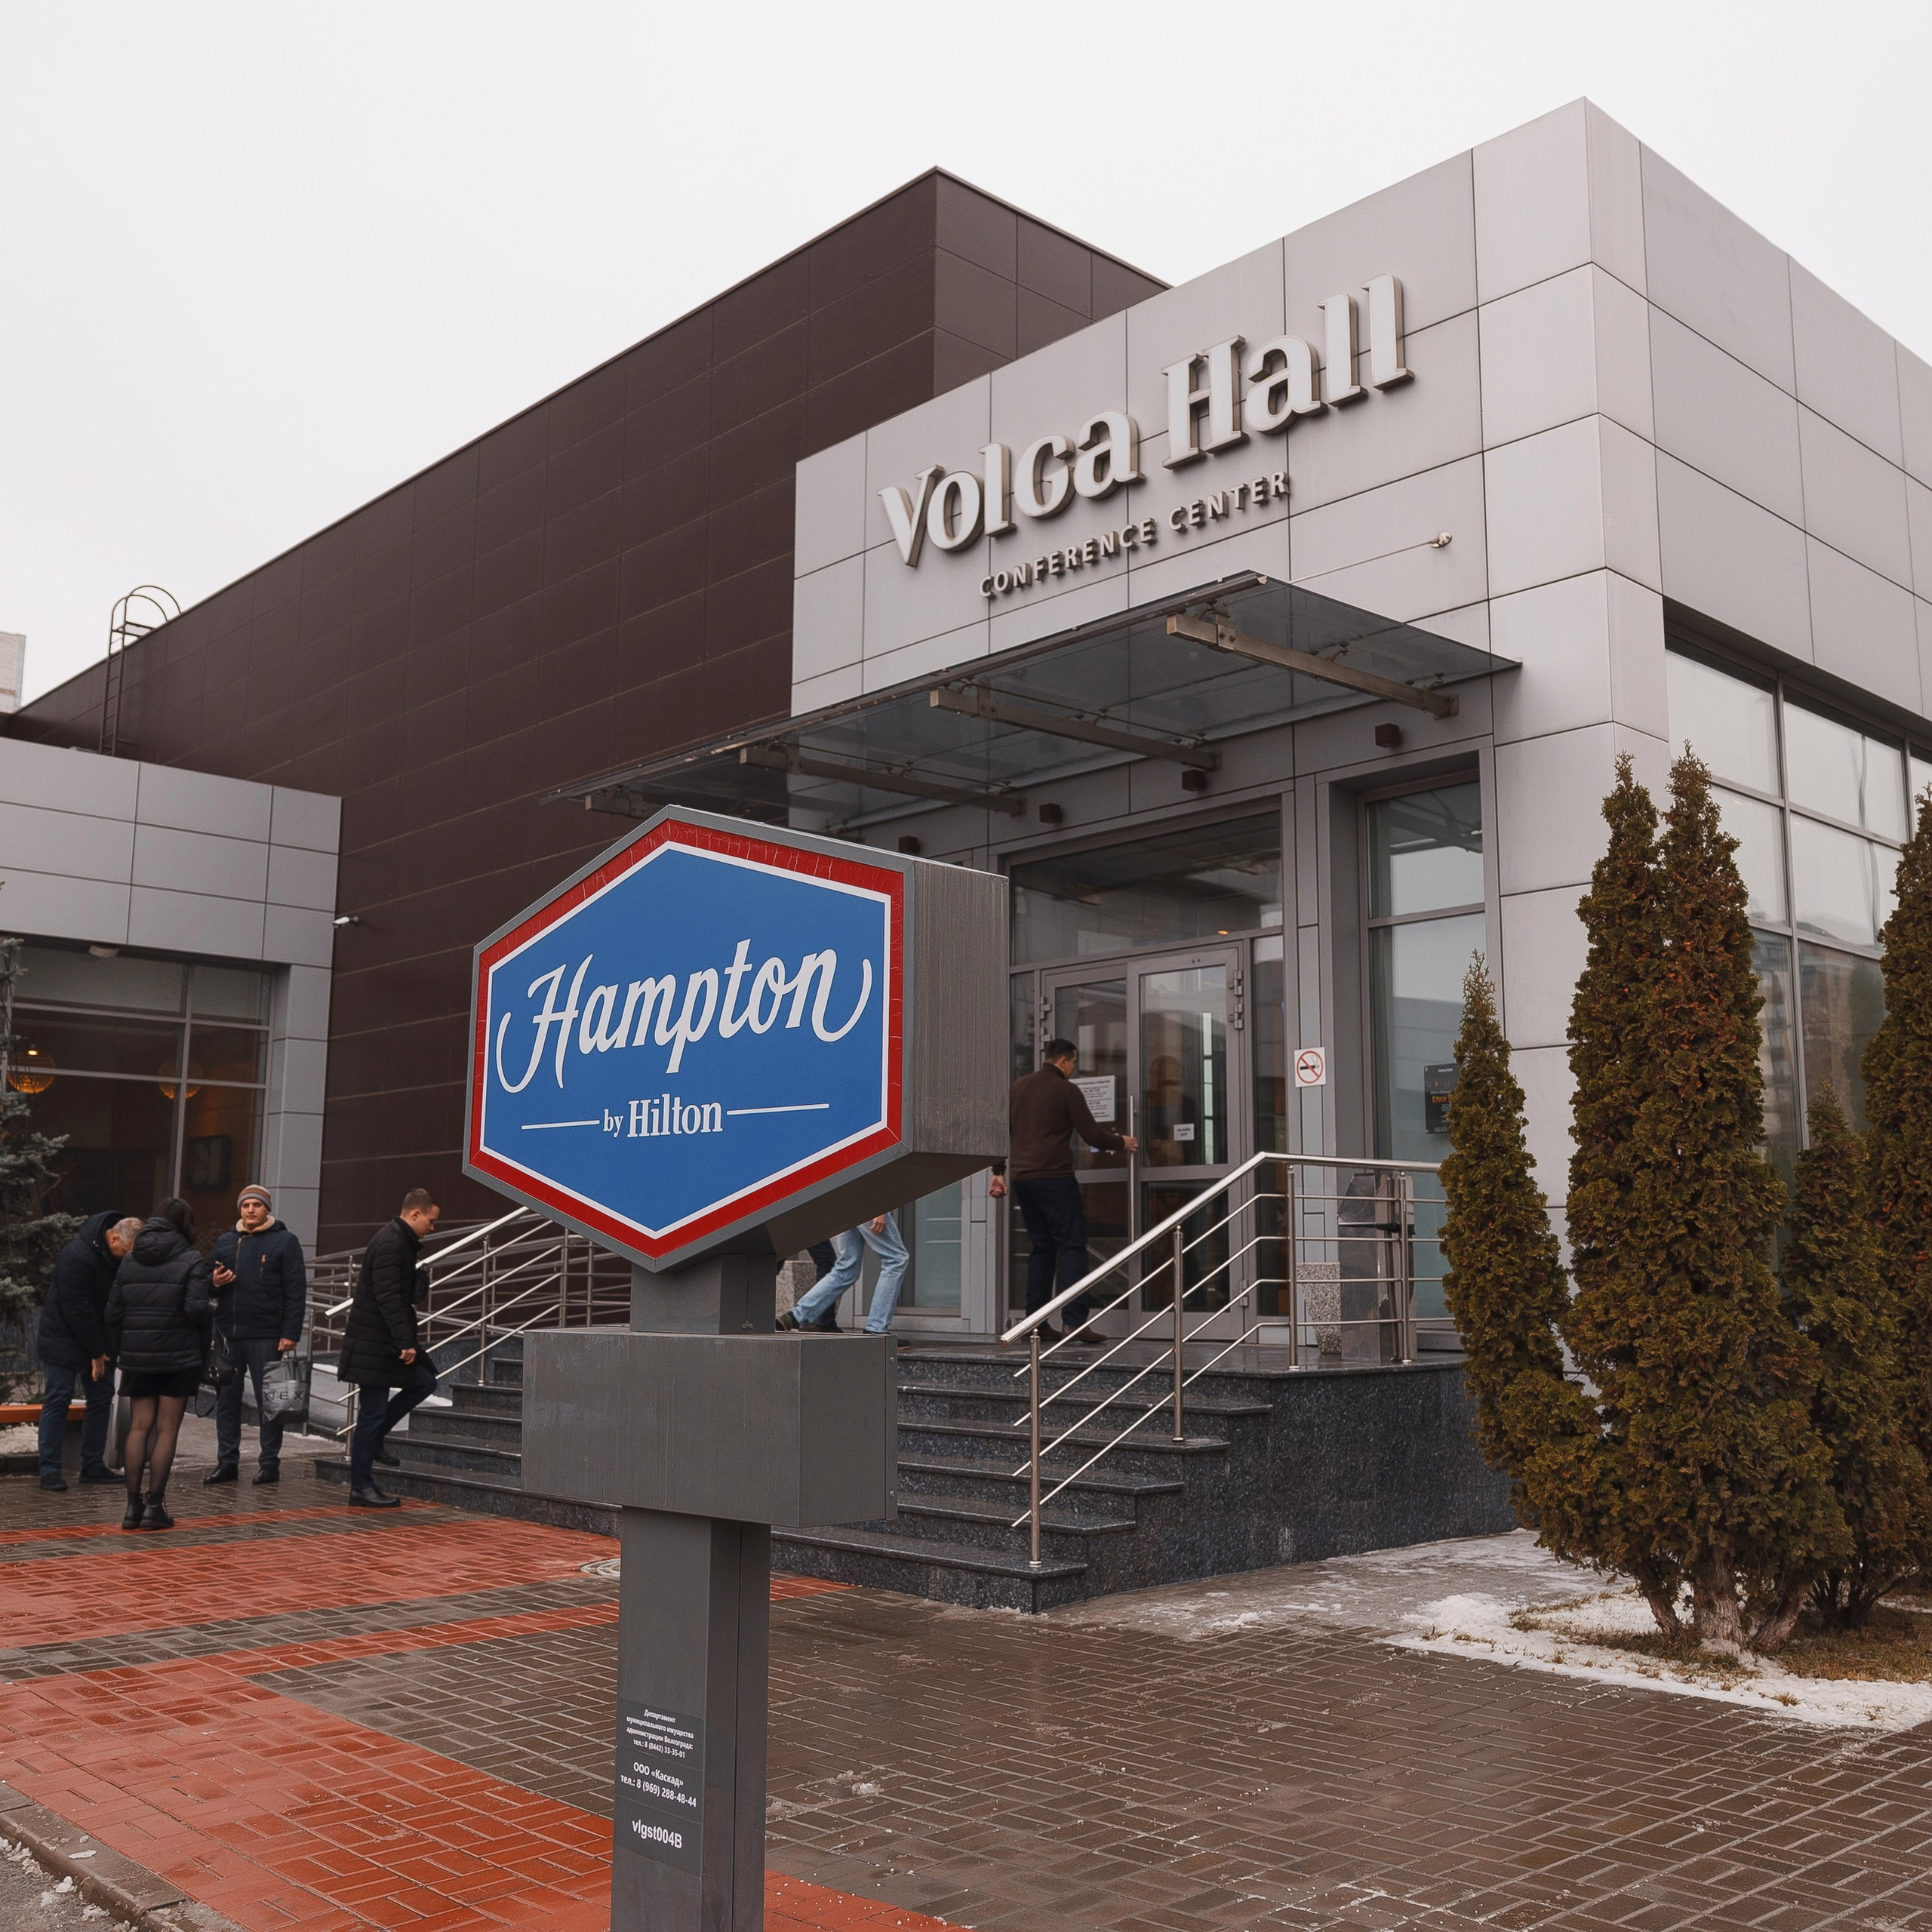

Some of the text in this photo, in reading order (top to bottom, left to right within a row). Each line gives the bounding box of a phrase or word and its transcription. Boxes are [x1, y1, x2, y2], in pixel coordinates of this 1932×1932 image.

[1161, 272, 1415, 471] Hall
[979, 470, 1291, 600] CONFERENCE CENTER
[495, 937, 873, 1094] Hampton
[603, 1093, 723, 1138] by Hilton
[626, 1715, 694, 1739] муниципального имущества
[644, 1709, 676, 1724] Департамент
[626, 1727, 694, 1750] администрации Волгограда:
[648, 1742, 664, 1754] (8442)
[664, 1746, 685, 1758] 33-35-01
[633, 1761, 684, 1789] ООО «Каскад»
[620, 1774, 697, 1808] тел.: 8 (969) 288-48-44
[632, 1819, 683, 1850] vlgst004B
